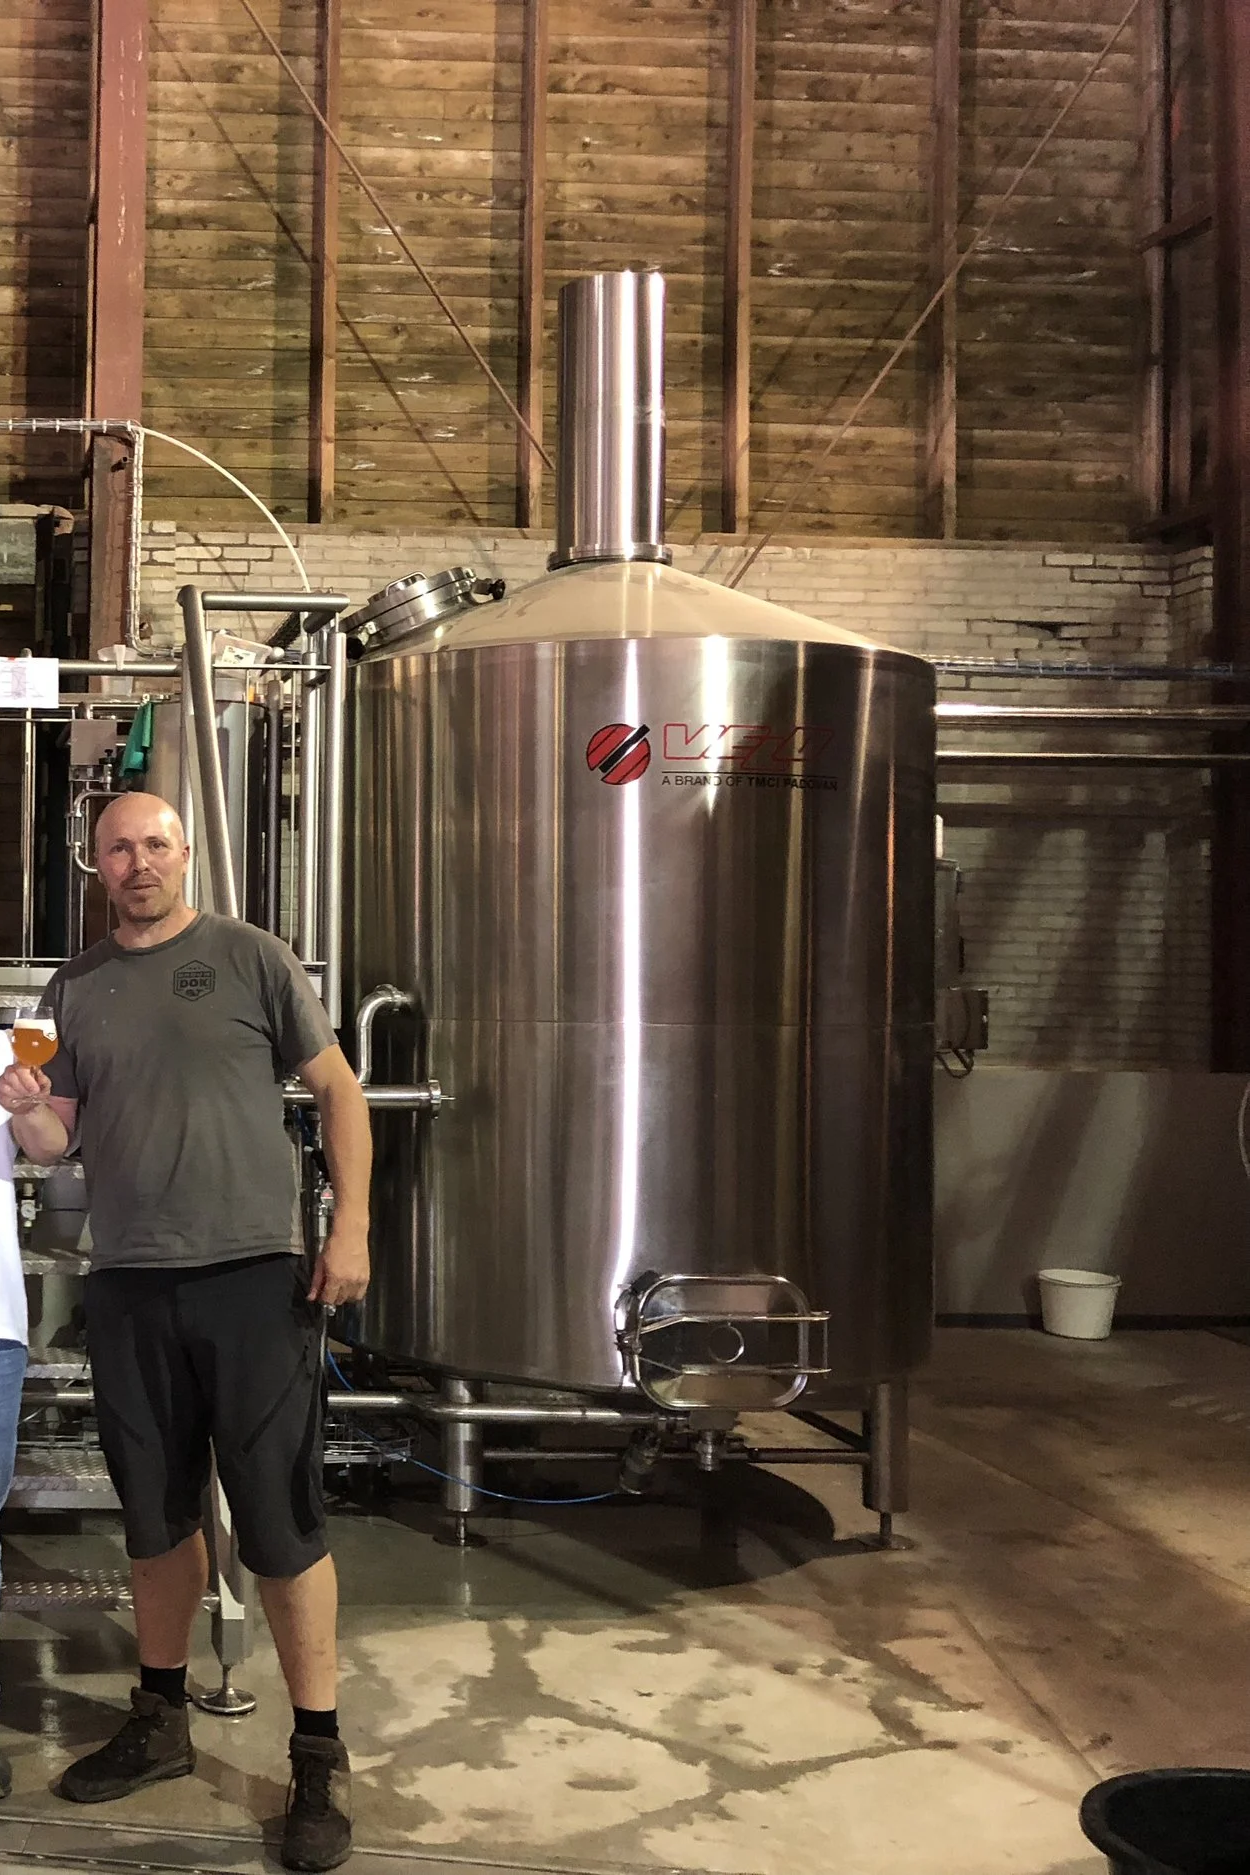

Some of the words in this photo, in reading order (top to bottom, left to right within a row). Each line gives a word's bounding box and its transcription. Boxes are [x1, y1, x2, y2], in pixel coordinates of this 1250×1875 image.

[661, 775, 671, 786] A
[725, 776, 746, 787] OF
[747, 776, 779, 788] TMCI
